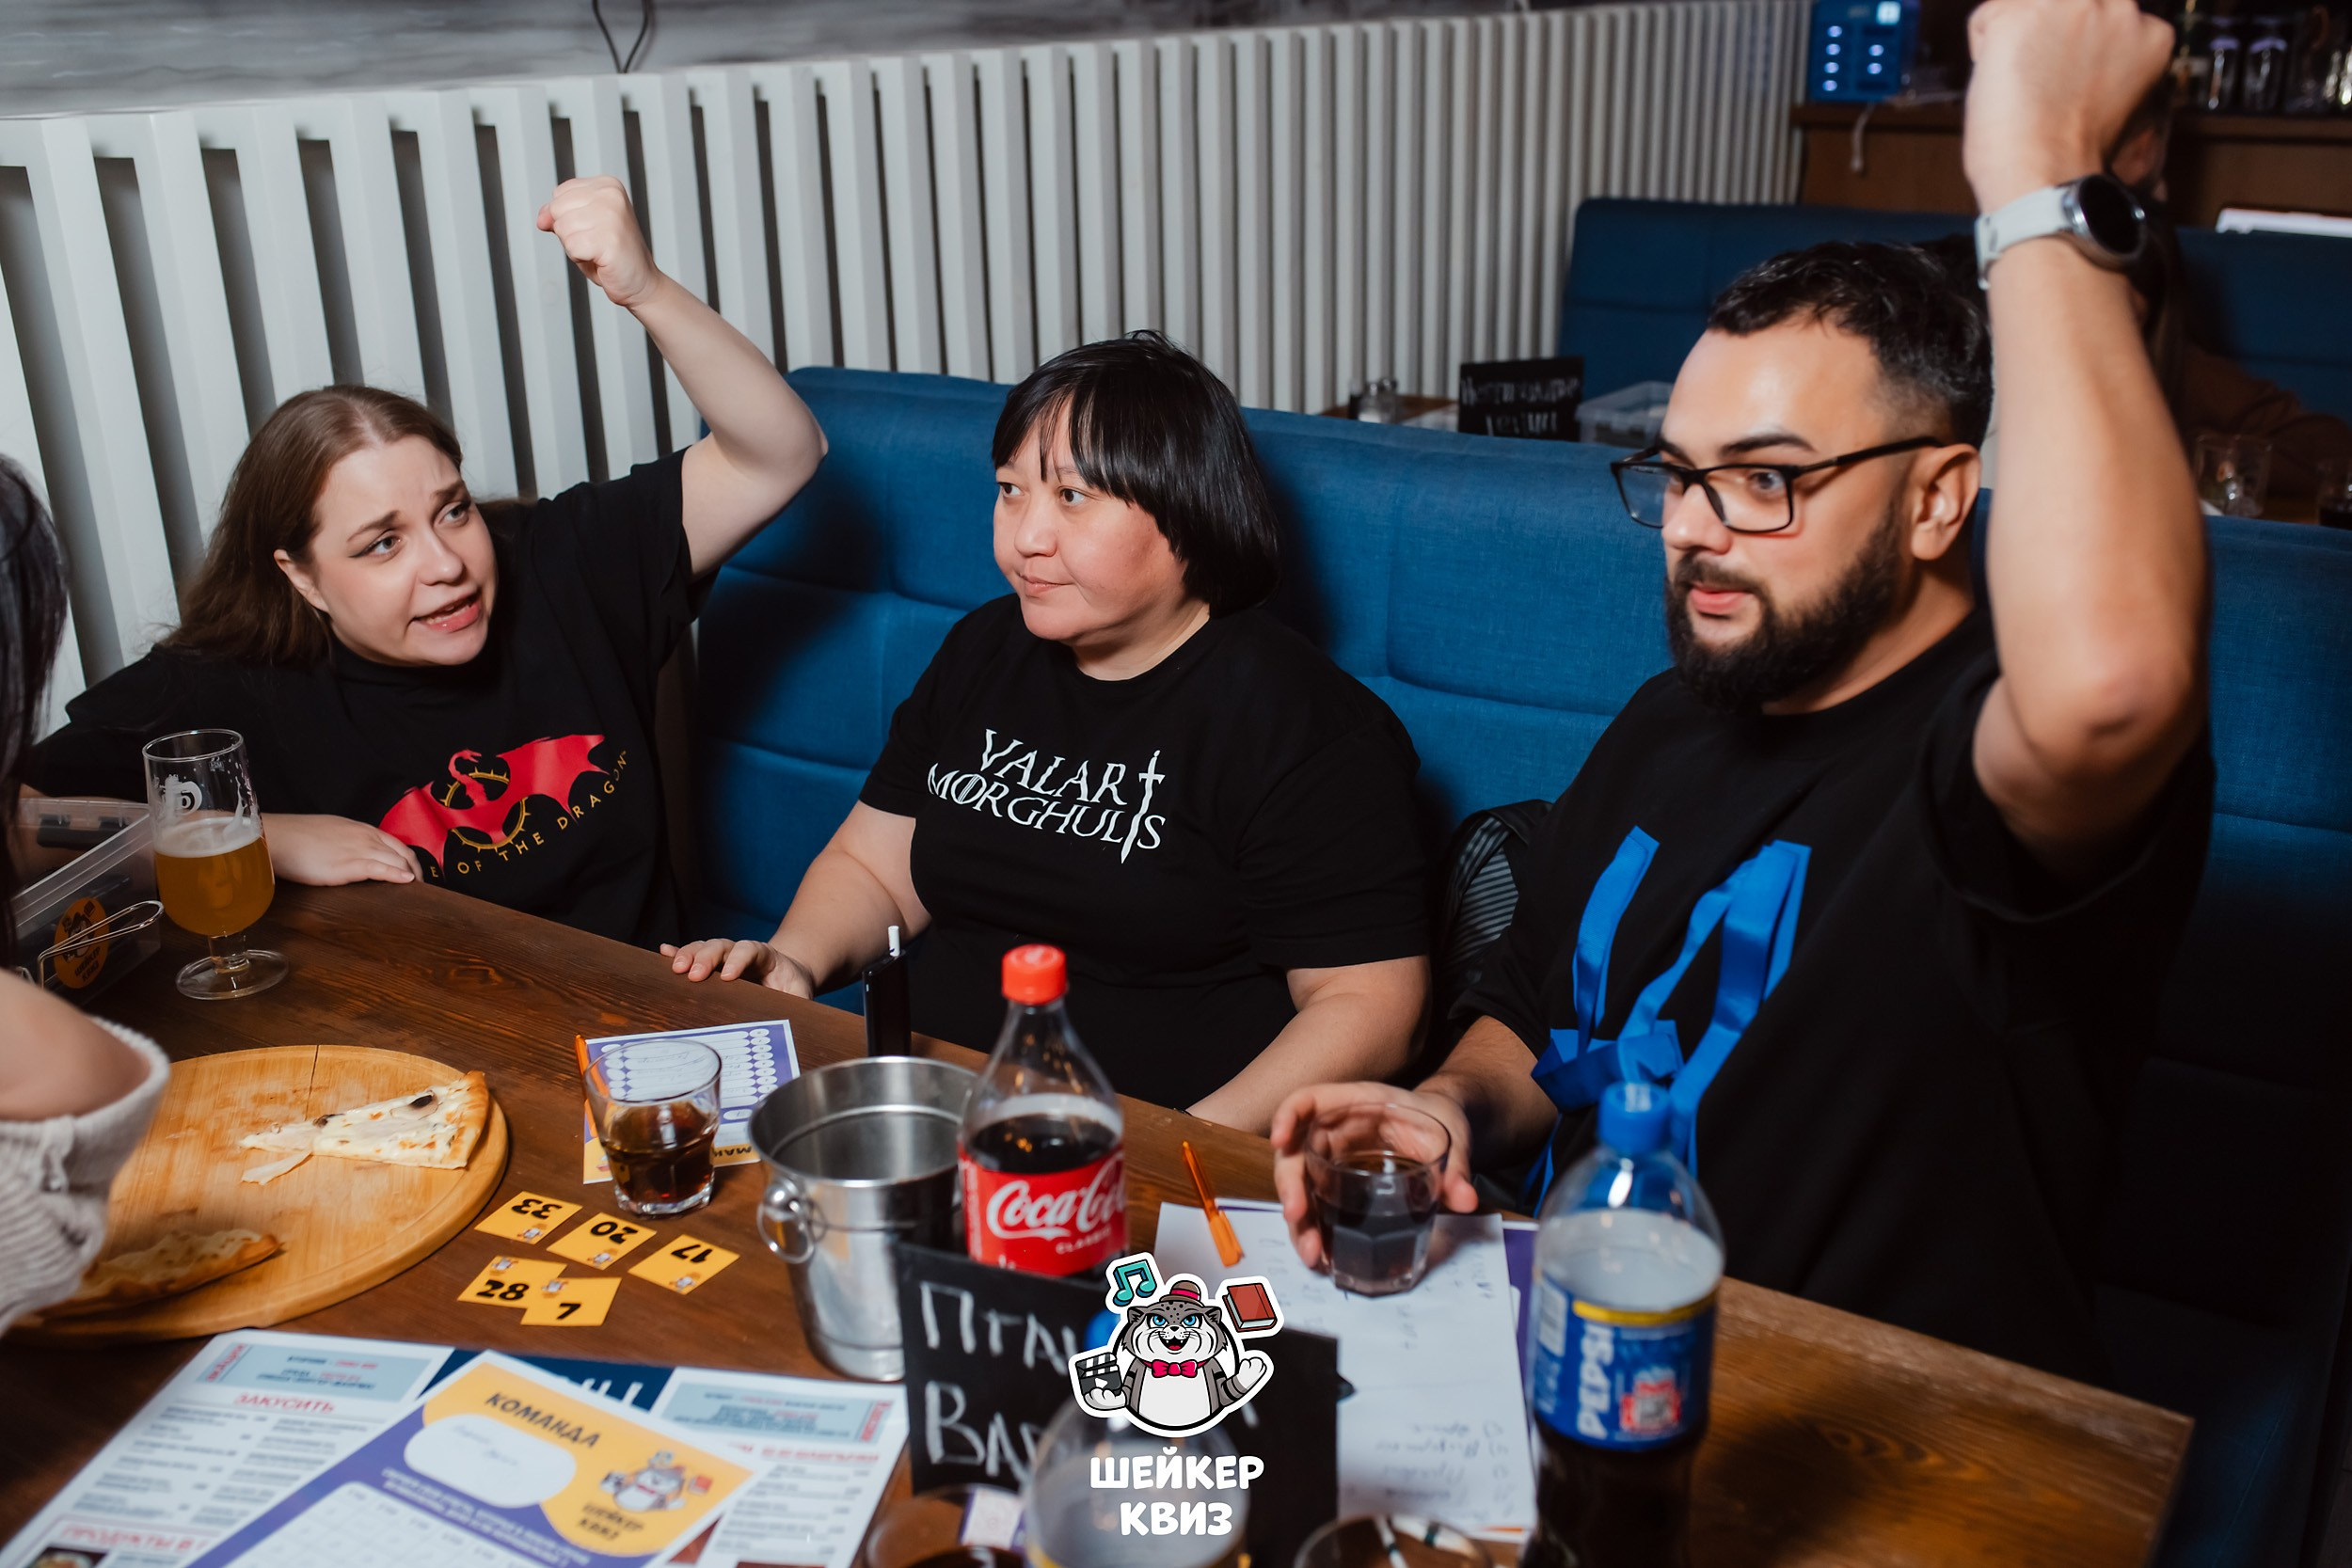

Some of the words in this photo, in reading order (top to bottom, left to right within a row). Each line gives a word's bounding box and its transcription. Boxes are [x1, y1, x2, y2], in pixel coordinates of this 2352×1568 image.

[980, 729, 1127, 806] VALAR
[928, 750, 1166, 863] MORGHULIS
[457, 860, 483, 876] OF
[499, 832, 545, 863] THE
[512, 1198, 562, 1219] 33
[591, 1221, 638, 1243] 20
[671, 1243, 713, 1263] 17
[476, 1279, 530, 1301] 28
[556, 1303, 581, 1321] 7
[485, 1391, 601, 1449] КОМАНДА
